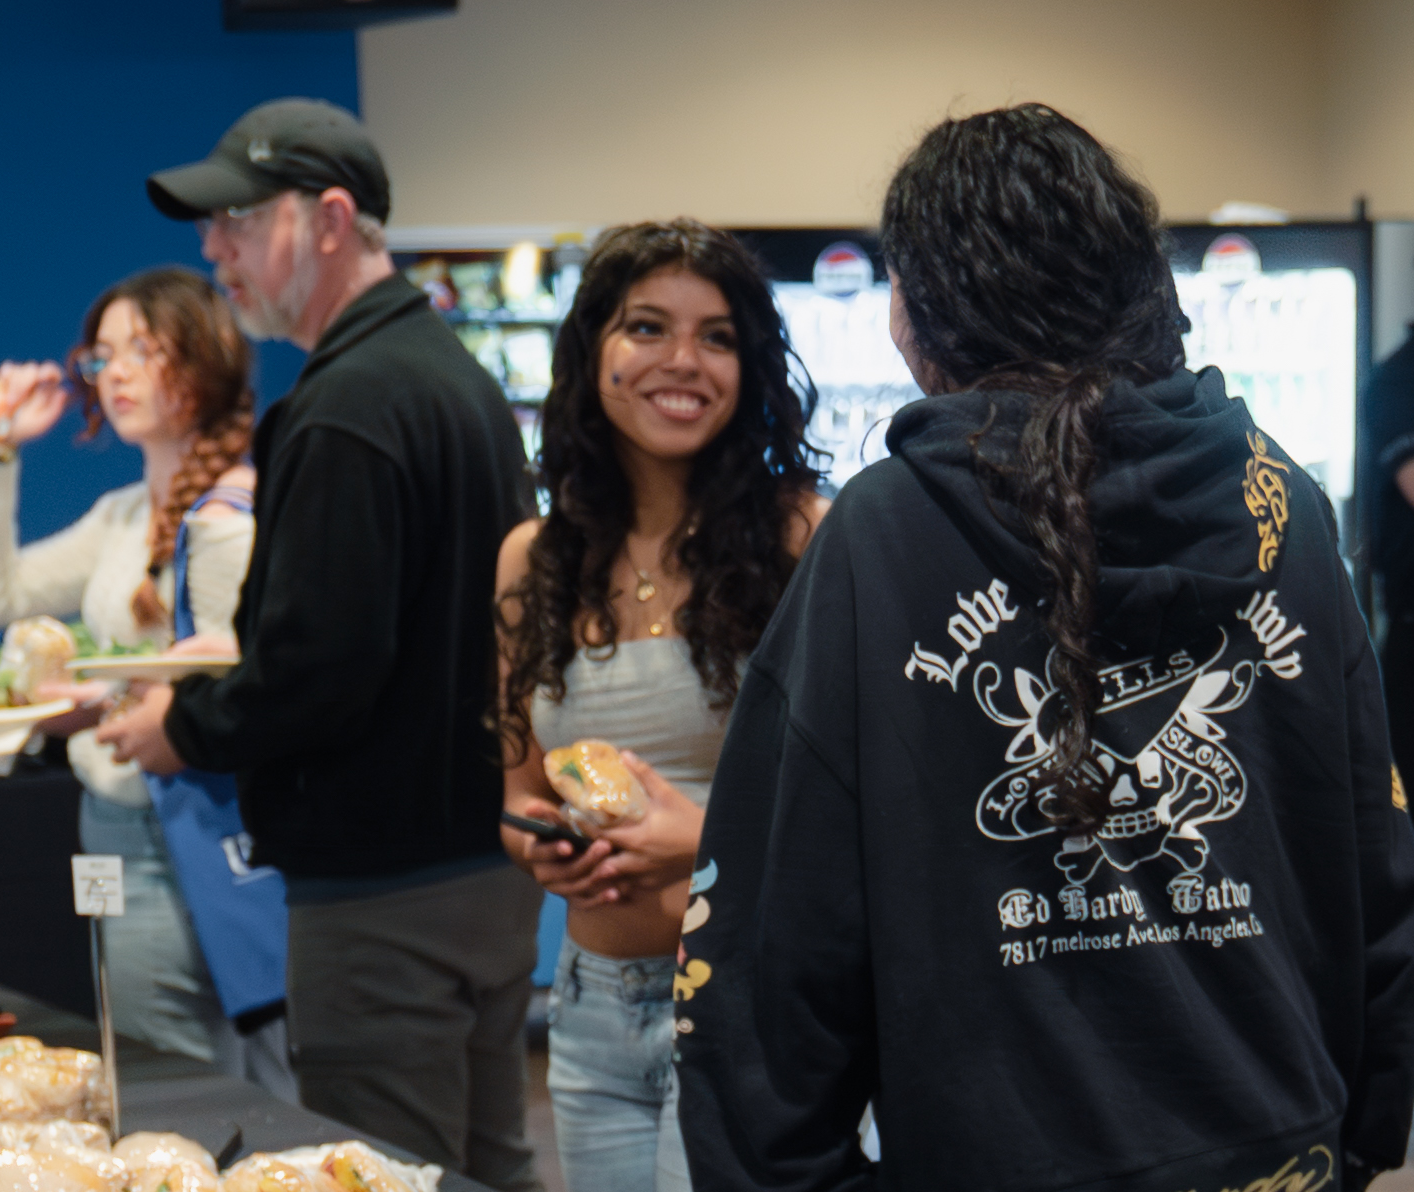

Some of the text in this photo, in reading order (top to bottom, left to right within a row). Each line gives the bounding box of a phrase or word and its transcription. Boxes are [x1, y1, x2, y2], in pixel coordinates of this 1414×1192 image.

[904, 577, 1020, 693] Love
[1161, 725, 1243, 808] SLOWLY
[1058, 883, 1147, 922] Hardy
[999, 936, 1048, 967] 7817
[1051, 930, 1121, 954] melrose
